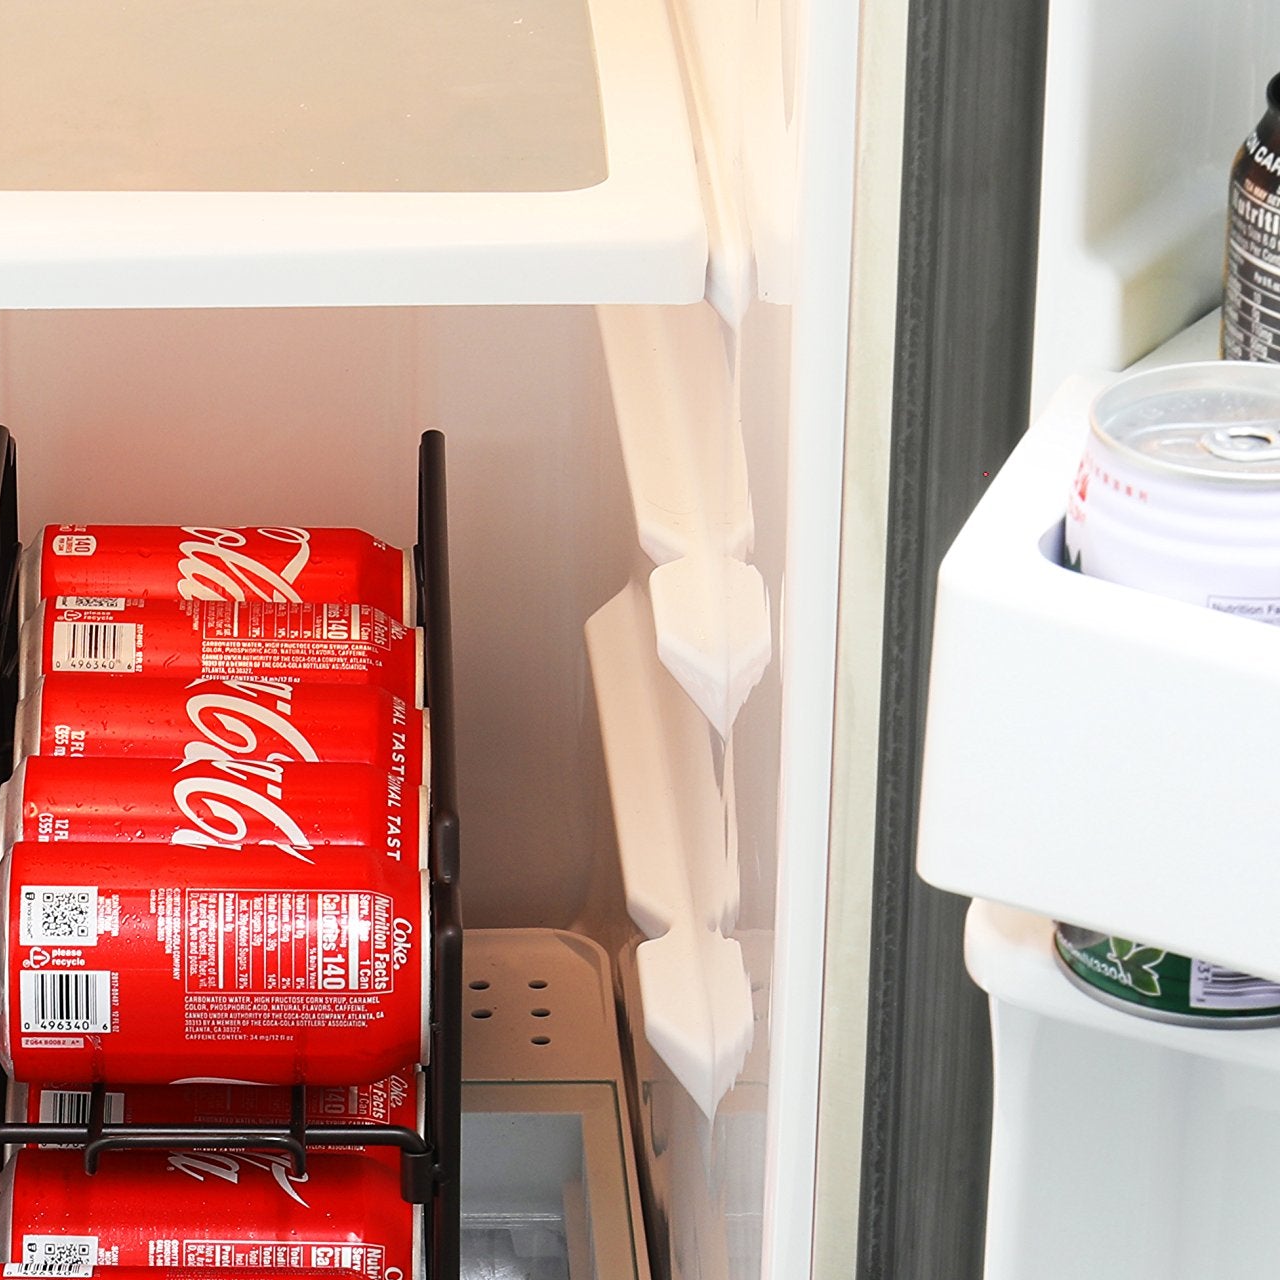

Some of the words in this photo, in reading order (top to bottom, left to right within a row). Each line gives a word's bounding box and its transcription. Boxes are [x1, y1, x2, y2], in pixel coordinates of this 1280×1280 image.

[74, 538, 91, 552] 140
[328, 619, 349, 639] 140
[361, 627, 371, 640] Can
[71, 660, 114, 669] 496340
[55, 725, 71, 745] (355
[71, 730, 85, 740] 12
[70, 741, 84, 752] FL
[391, 733, 405, 773] TAST
[55, 819, 69, 829] 12
[386, 816, 401, 861] TAST
[360, 894, 371, 918] Serv.
[322, 894, 341, 951] Calories
[374, 896, 390, 949] Nutrition
[52, 949, 82, 958] please
[238, 948, 248, 970] Sugars
[52, 958, 85, 967] recycle
[173, 950, 181, 980] COMPANY
[323, 954, 346, 990] 140
[360, 968, 371, 989] Can
[374, 953, 389, 990] Facts
[239, 973, 248, 989] 78%
[267, 973, 276, 989] 14%
[282, 977, 291, 989] 2%
[296, 977, 305, 989] 0%
[184, 996, 226, 1004] CARBONATED
[228, 996, 252, 1005] WATER,
[254, 996, 269, 1004] HIGH
[271, 996, 304, 1004] FRUCTOSE
[306, 996, 324, 1004] CORN
[349, 996, 380, 1004] CARAMEL
[184, 1004, 208, 1012] COLOR,
[303, 1004, 332, 1012] FLAVORS,
[334, 1004, 368, 1012] CAFFEINE.
[376, 1011, 384, 1019] GA
[24, 1022, 30, 1030] 0
[41, 1021, 89, 1030] 496340
[325, 1087, 345, 1114] 140
[359, 1098, 369, 1115] Can
[372, 1089, 388, 1118] Facts
